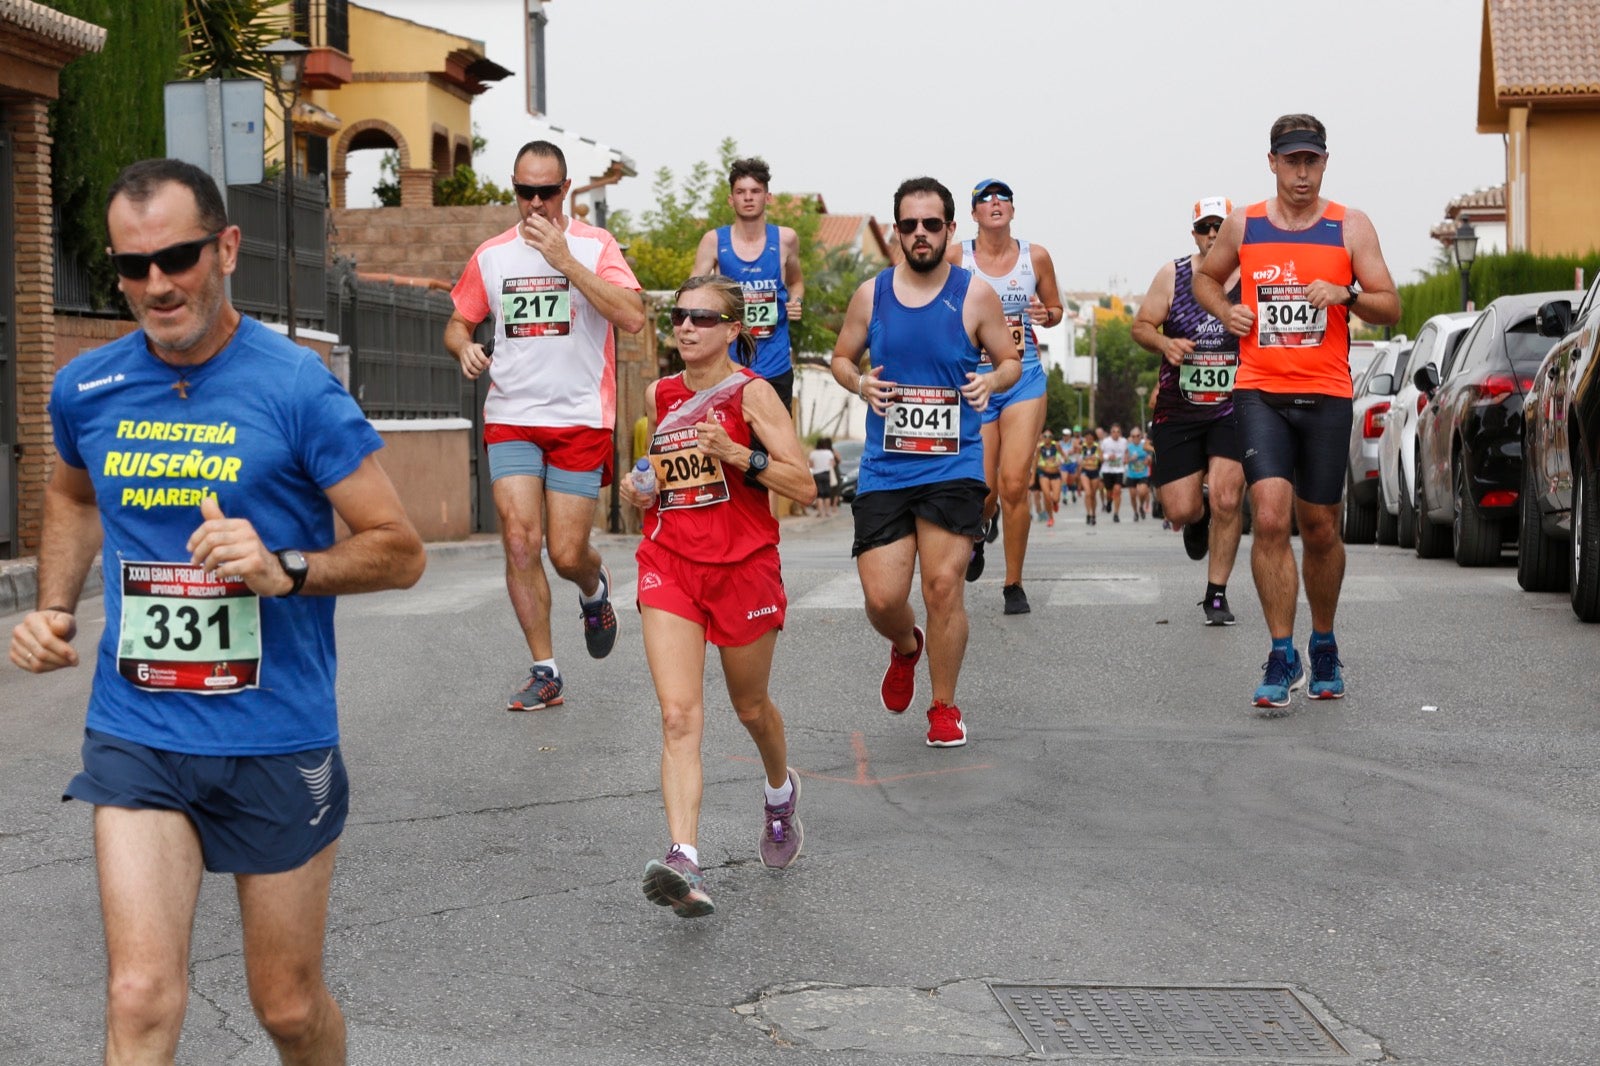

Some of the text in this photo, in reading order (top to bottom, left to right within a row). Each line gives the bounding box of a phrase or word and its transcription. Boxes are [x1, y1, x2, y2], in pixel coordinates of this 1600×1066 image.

[513, 295, 559, 319] 217
[747, 306, 770, 323] 52
[1267, 305, 1319, 325] 3047
[1012, 330, 1022, 346] 9
[1189, 369, 1230, 388] 430
[895, 406, 952, 430] 3041
[116, 420, 237, 444] FLORISTERÍA
[104, 449, 242, 482] RUISEÑOR
[661, 454, 716, 482] 2084
[151, 567, 174, 582] GRAN
[174, 568, 205, 583] PREMIO
[144, 604, 231, 652] 331
